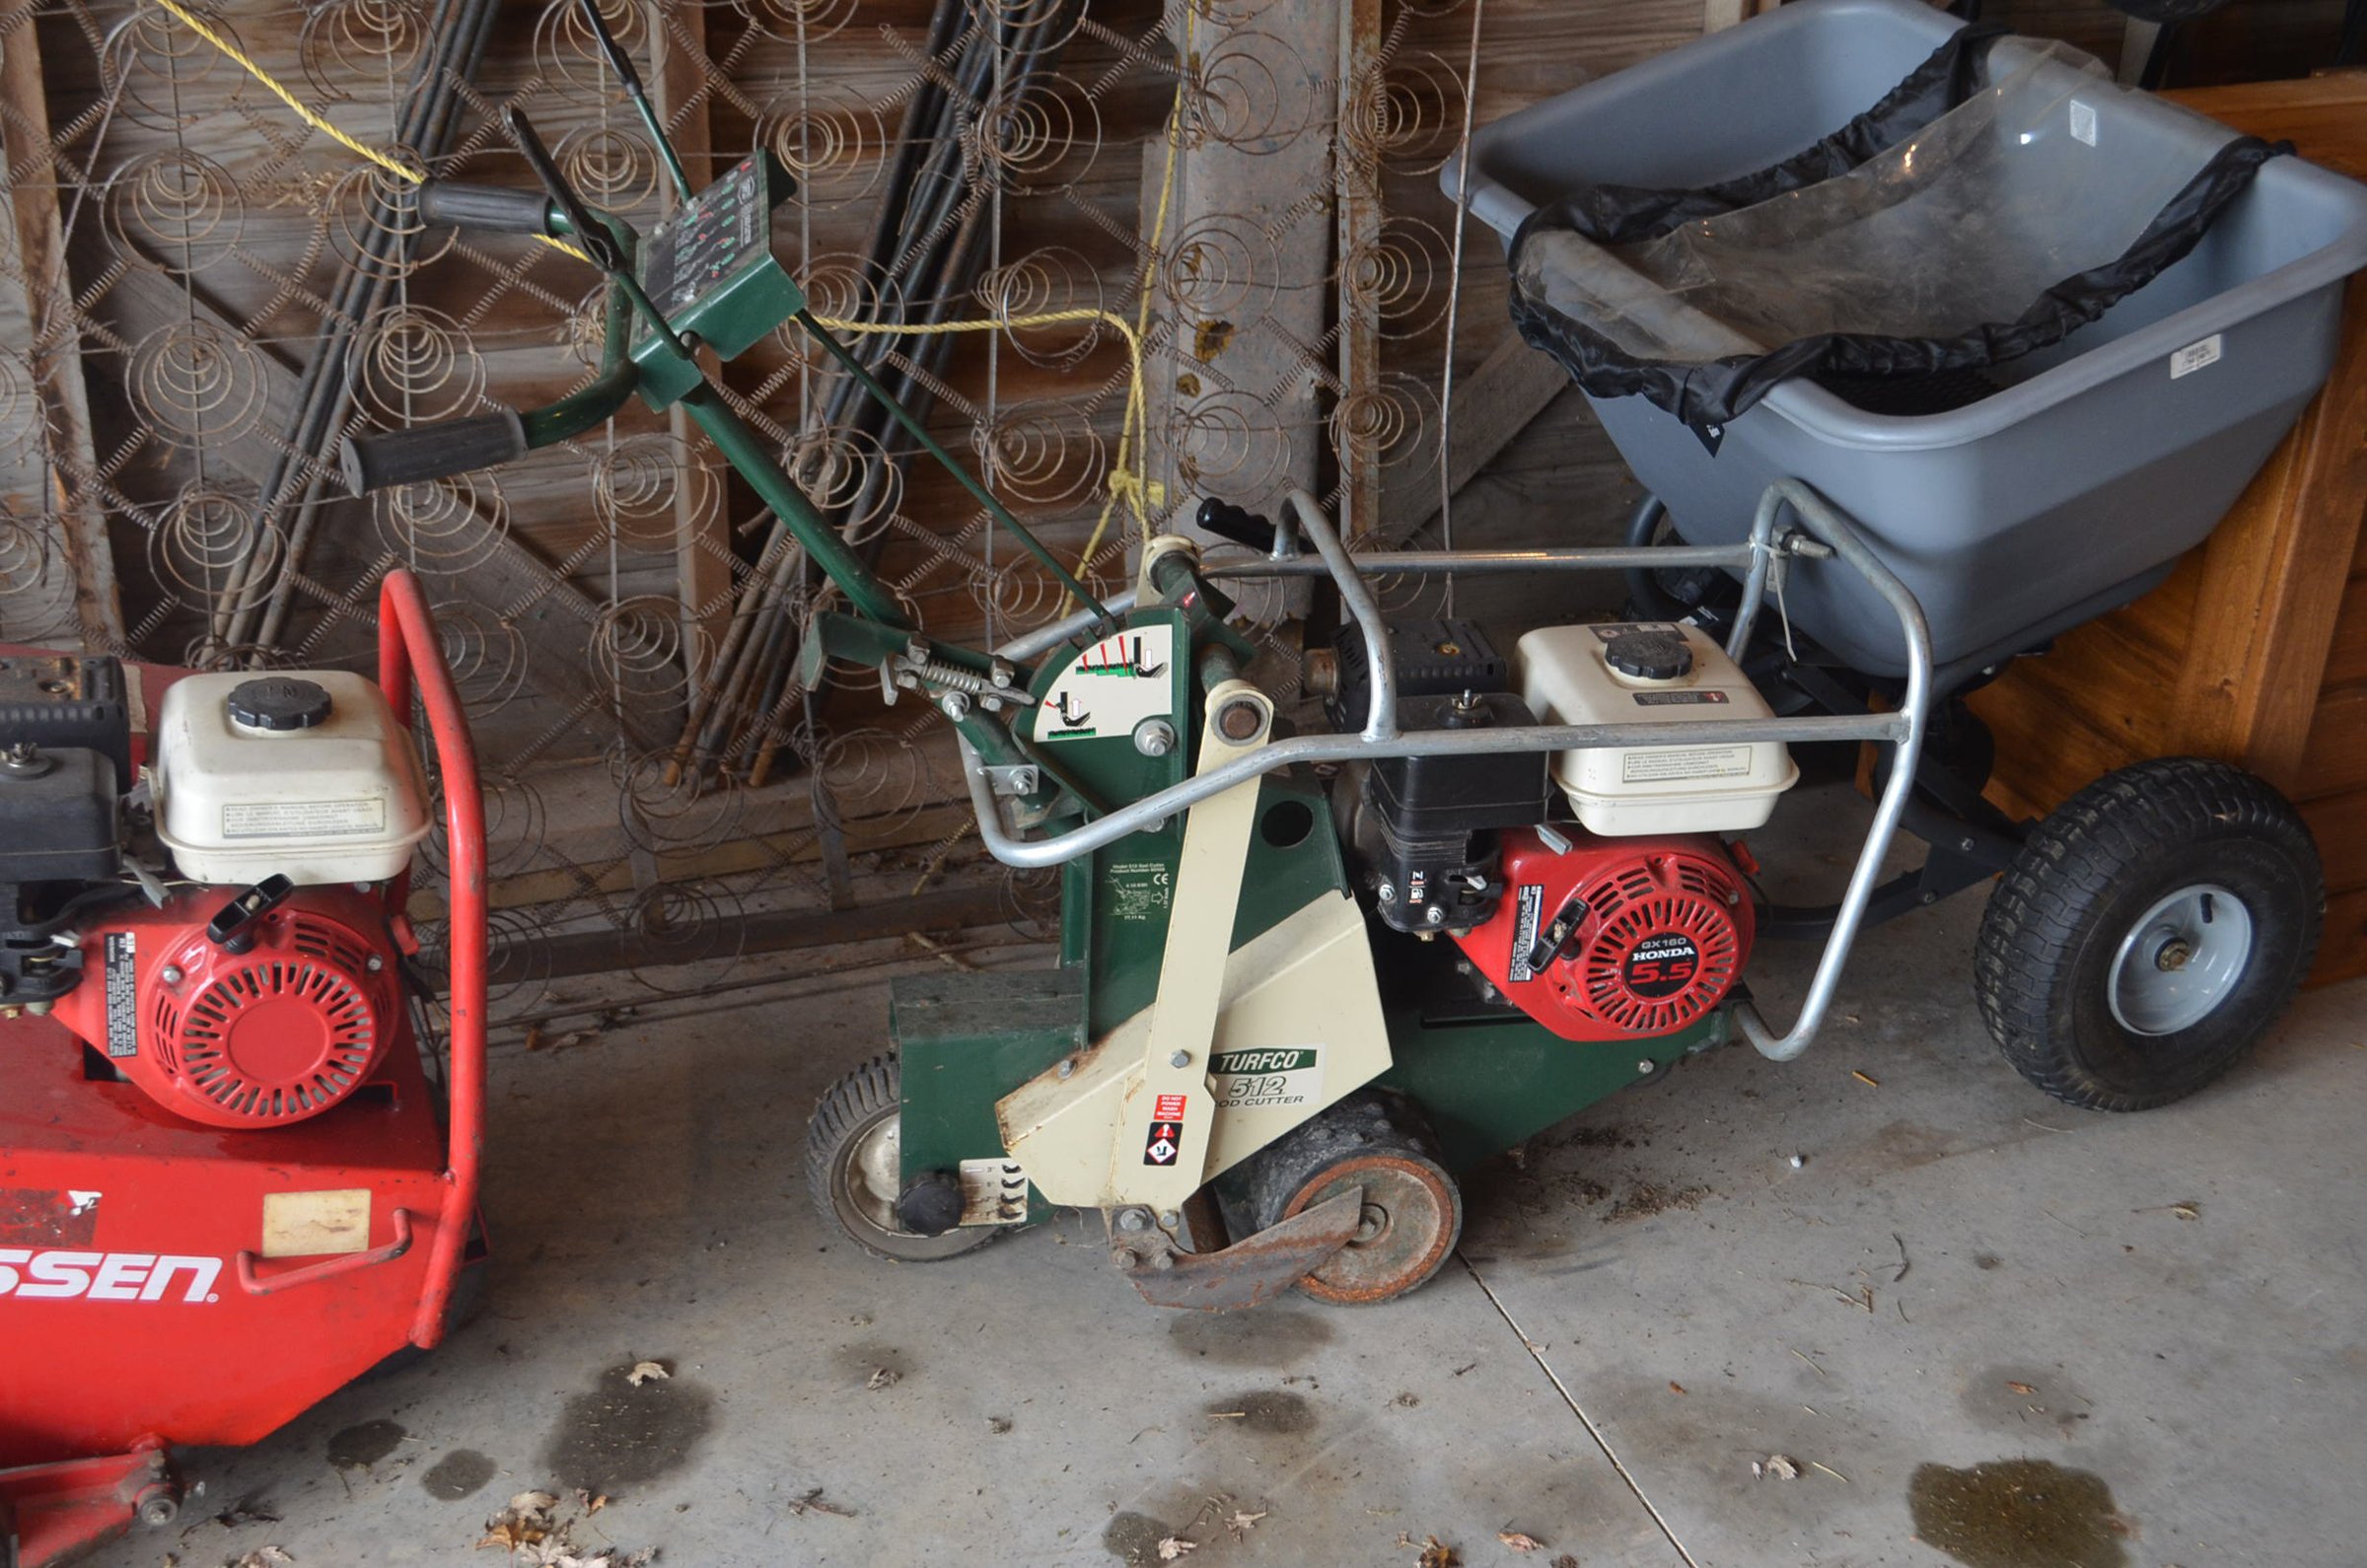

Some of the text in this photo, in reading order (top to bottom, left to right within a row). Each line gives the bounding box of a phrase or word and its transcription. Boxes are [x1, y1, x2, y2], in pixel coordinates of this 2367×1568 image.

[1641, 937, 1687, 950] GX160
[1632, 947, 1695, 962] HONDA
[1629, 962, 1693, 985] 5.5
[1219, 1050, 1300, 1073] TURFCO
[1228, 1075, 1286, 1099] 512
[1245, 1095, 1304, 1106] CUTTER
